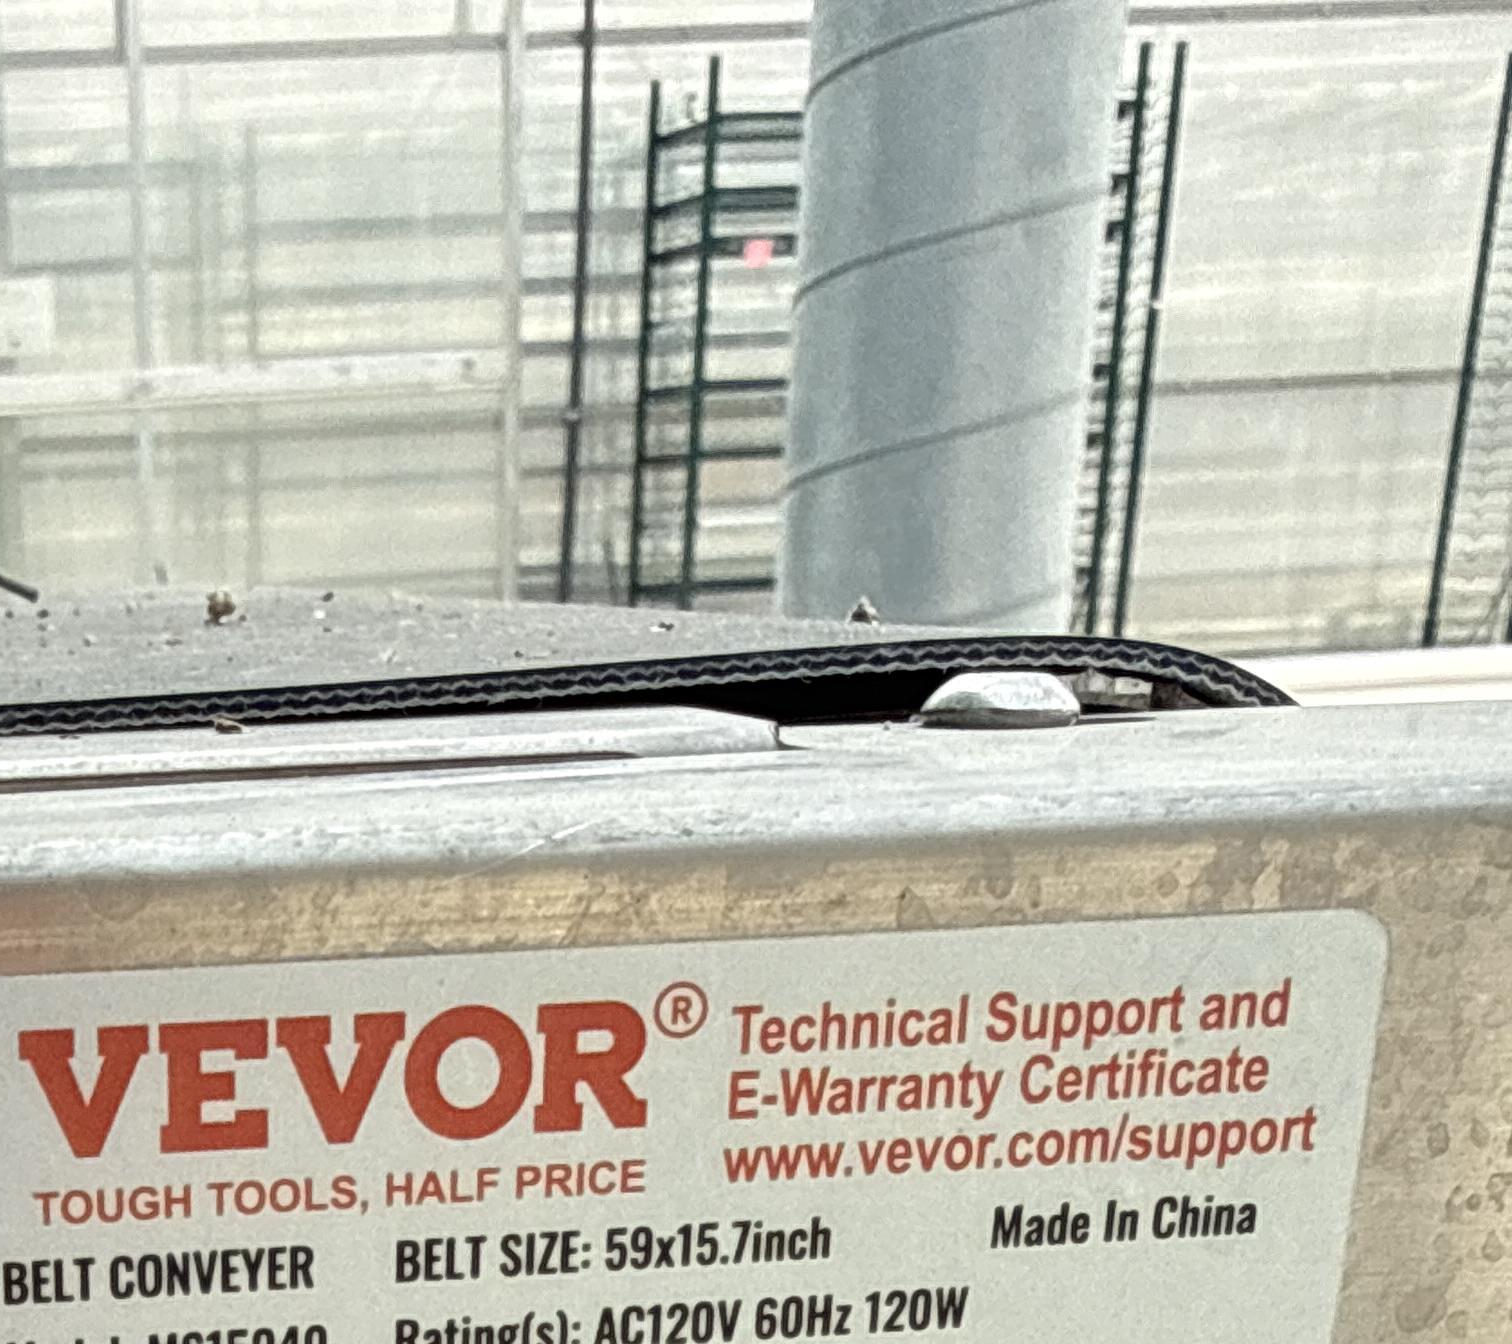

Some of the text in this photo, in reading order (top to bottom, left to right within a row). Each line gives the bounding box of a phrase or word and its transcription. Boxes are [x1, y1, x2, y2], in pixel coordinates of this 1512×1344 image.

[732, 977, 1291, 1056] Technical Support and
[729, 1046, 1269, 1120] E-Warranty Certificate
[723, 1106, 1317, 1183] www.vevor.com/support
[33, 1159, 646, 1225] TOUGH TOOLS, HALF PRICE
[991, 1195, 1257, 1248] Made In China
[3, 1246, 314, 1305] BELT CONVEYER
[396, 1216, 831, 1283] BELT SIZE: 59x15.7inch
[755, 1294, 852, 1340] 60Hz
[865, 1287, 969, 1333] 120W
